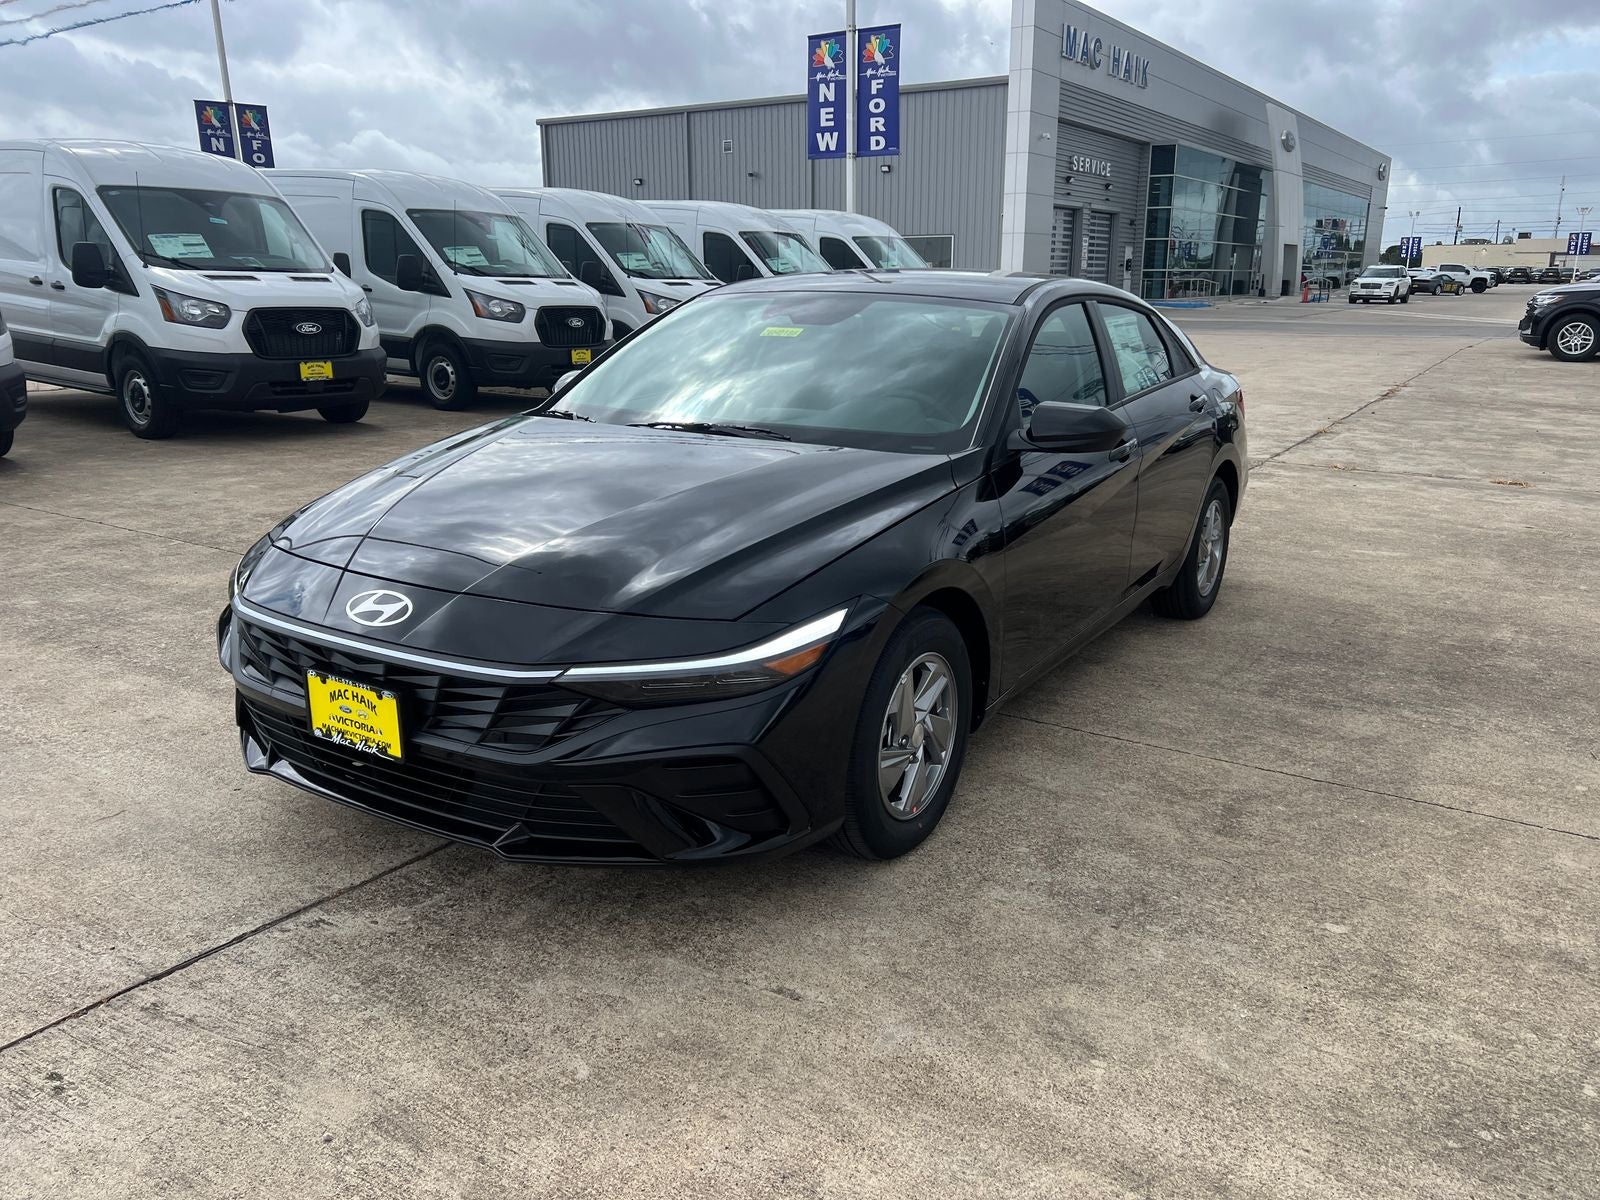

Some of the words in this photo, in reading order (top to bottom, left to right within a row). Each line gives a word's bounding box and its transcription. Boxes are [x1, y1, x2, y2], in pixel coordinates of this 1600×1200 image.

[1061, 22, 1102, 70] MAC
[1107, 44, 1149, 89] HAIK
[816, 82, 838, 151] NEW
[868, 79, 886, 151] FORD
[1072, 155, 1111, 176] SERVICE
[329, 688, 350, 703] MAC
[351, 690, 378, 716] HAIK
[335, 715, 375, 735] VICTORIA
[331, 731, 354, 747] Mac
[355, 740, 379, 754] Haik
